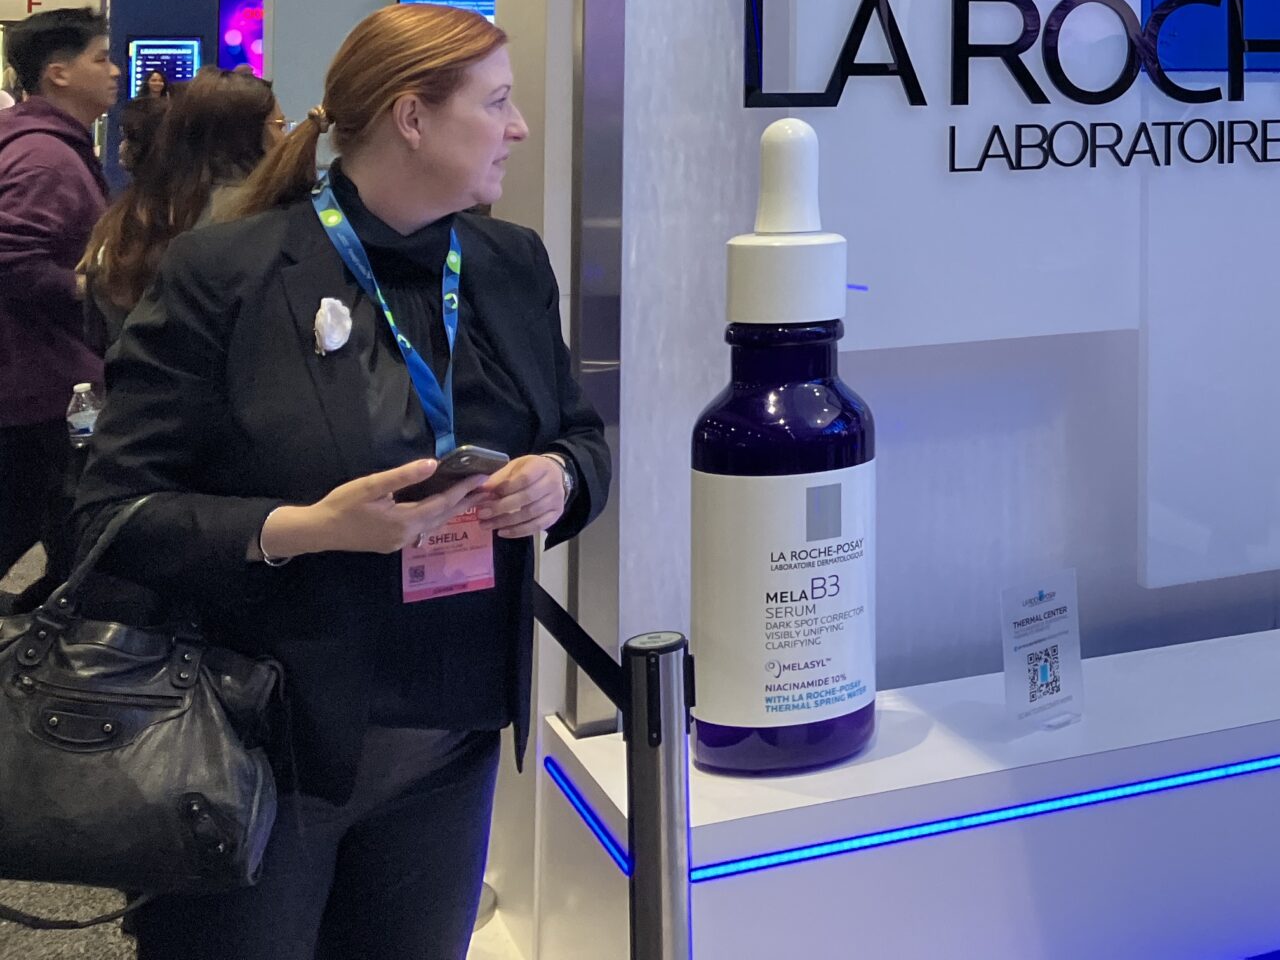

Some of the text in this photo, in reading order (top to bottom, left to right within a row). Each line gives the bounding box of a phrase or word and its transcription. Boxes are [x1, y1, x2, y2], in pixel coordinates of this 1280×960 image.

[428, 530, 469, 546] SHEILA
[770, 538, 864, 563] LA ROCHE-POSAY
[770, 550, 864, 572] LABORATOIRE DERMATOLOGIQUE
[765, 603, 816, 619] SERUM
[765, 605, 865, 631] DARK SPOT CORRECTOR
[1012, 614, 1043, 629] THERMAL
[1043, 605, 1068, 620] CENTER
[765, 622, 844, 640] VISIBLY UNIFYING
[765, 637, 822, 651] CLARIFYING
[765, 673, 847, 693] NIACINAMIDE 10%
[765, 680, 862, 704] WITH LA ROCHE-POSAY
[765, 685, 867, 713] THERMAL SPRING WATER
